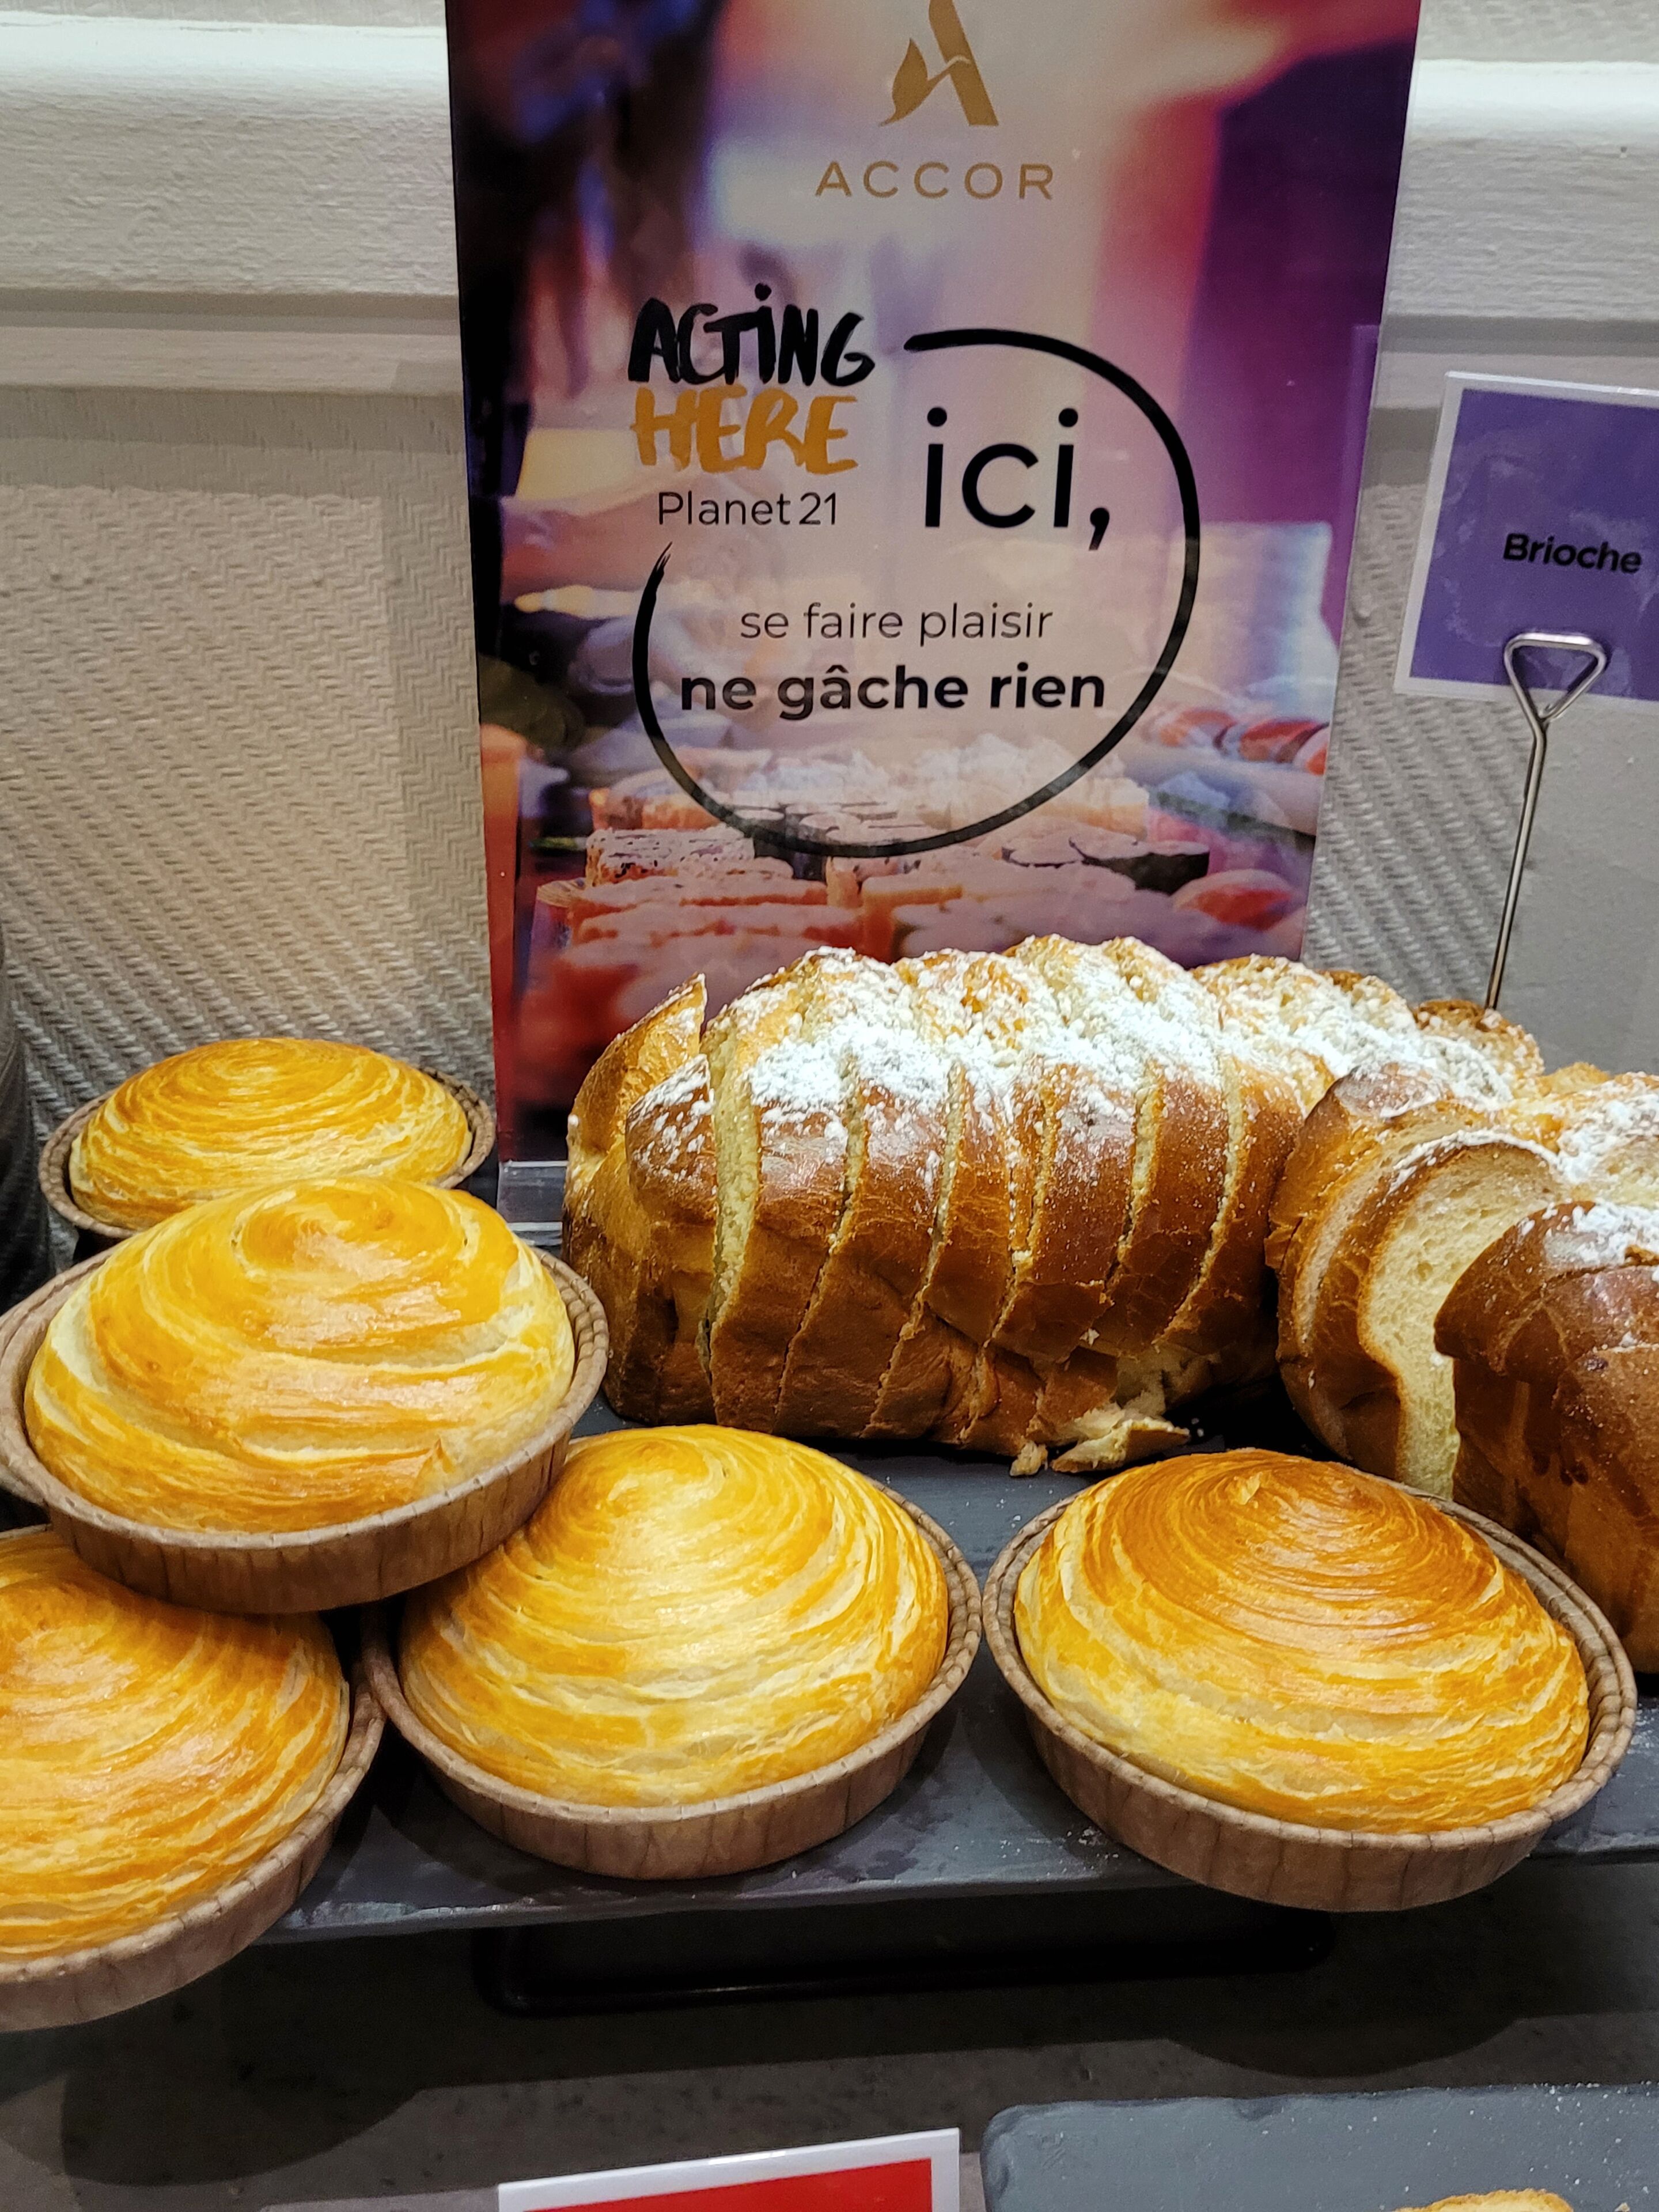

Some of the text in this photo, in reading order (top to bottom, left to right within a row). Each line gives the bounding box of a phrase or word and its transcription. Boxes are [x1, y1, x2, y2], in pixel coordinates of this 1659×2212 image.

[815, 161, 1054, 200] ACCOR
[630, 385, 859, 475] HERE
[923, 407, 1111, 551] ici,
[1502, 533, 1642, 574] Brioche
[740, 602, 1053, 646] se faire plaisir
[680, 662, 1105, 721] ne gâche rien
